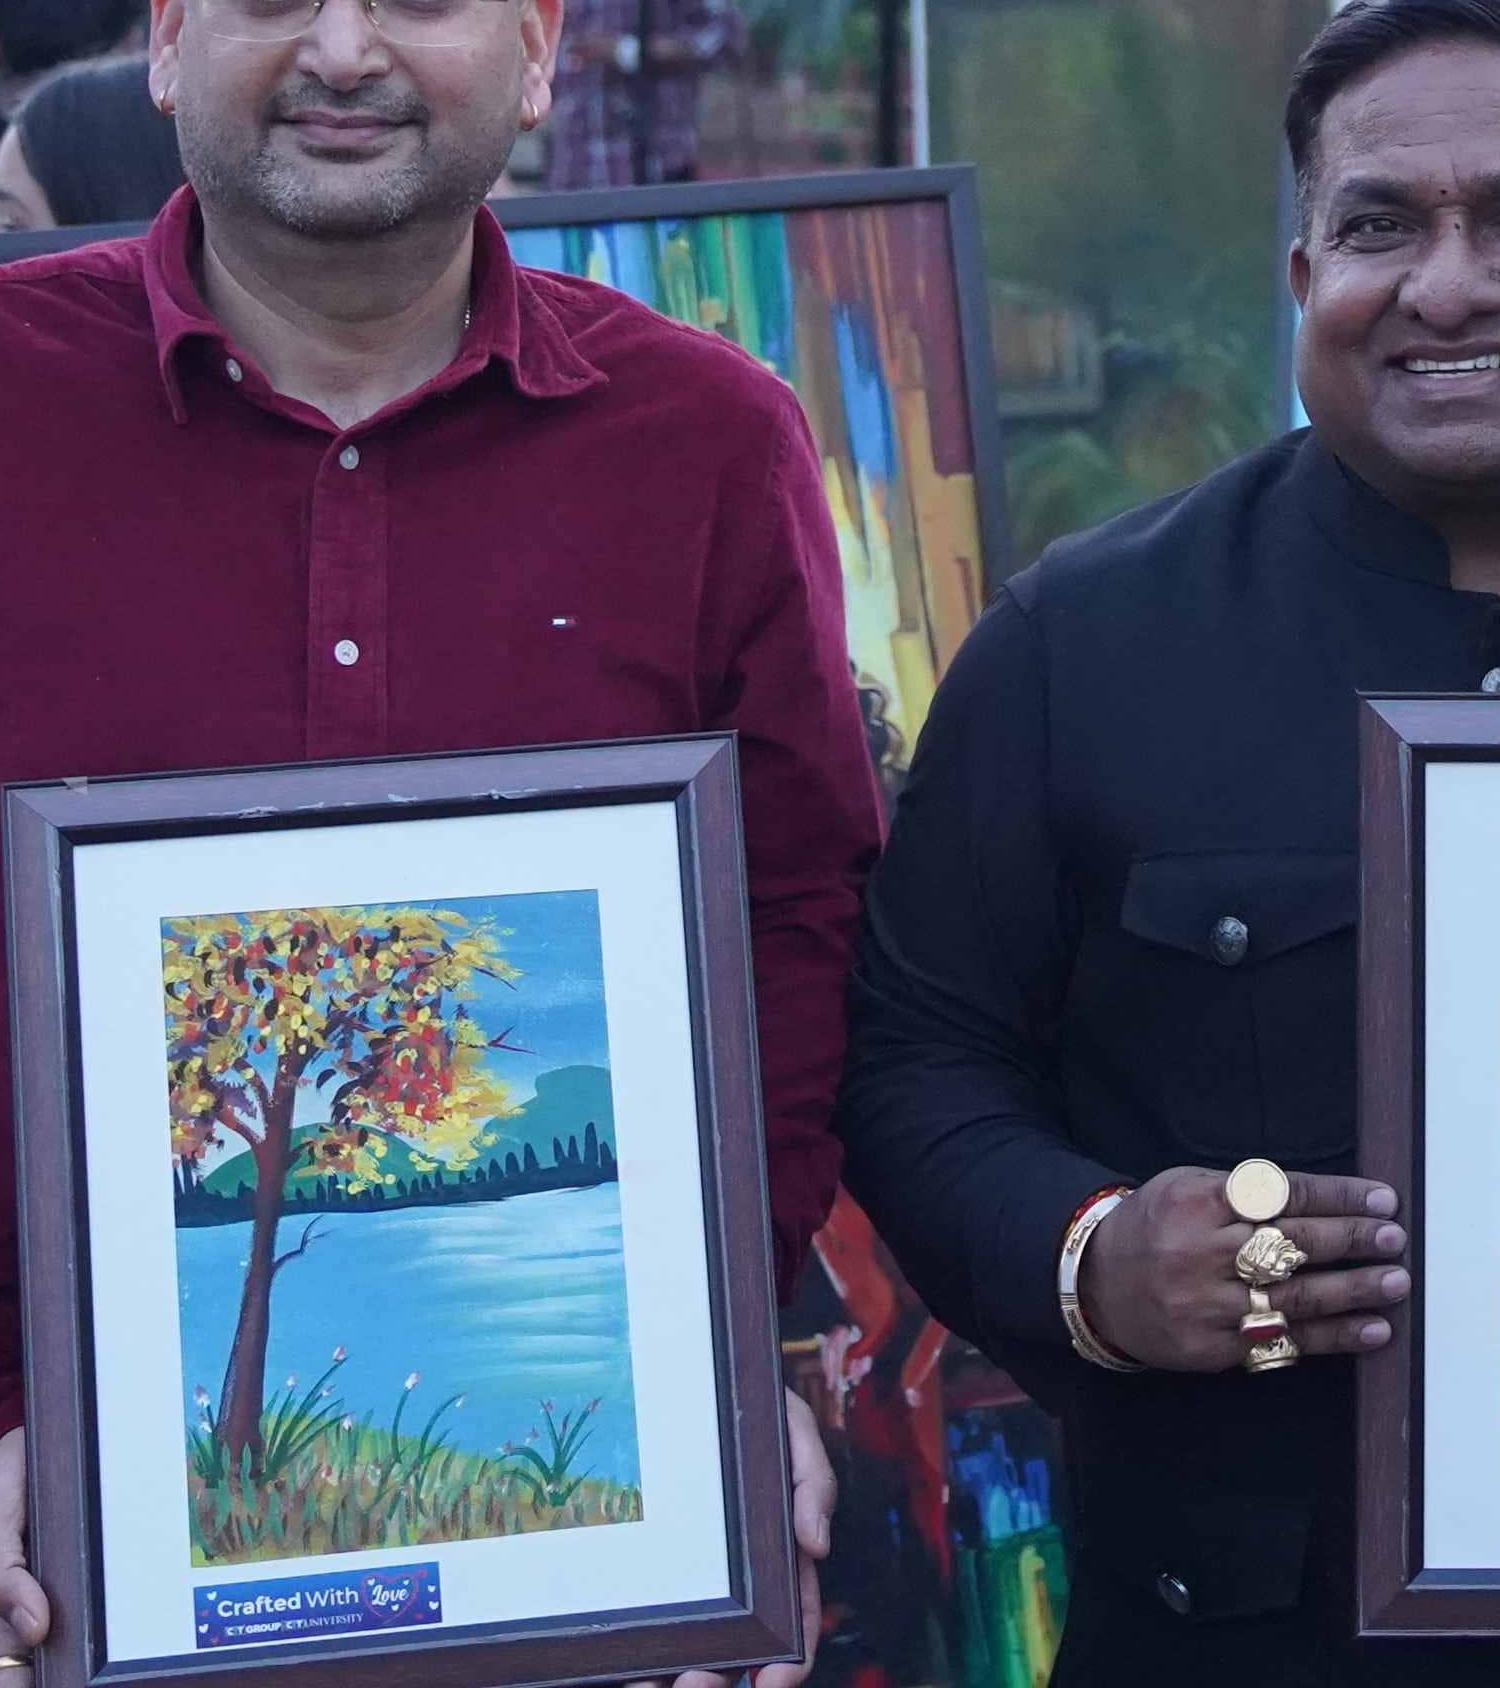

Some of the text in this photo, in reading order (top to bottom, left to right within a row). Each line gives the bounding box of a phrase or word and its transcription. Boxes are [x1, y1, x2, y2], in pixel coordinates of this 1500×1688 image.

[217, 1584, 409, 1617] Crafted With Love
